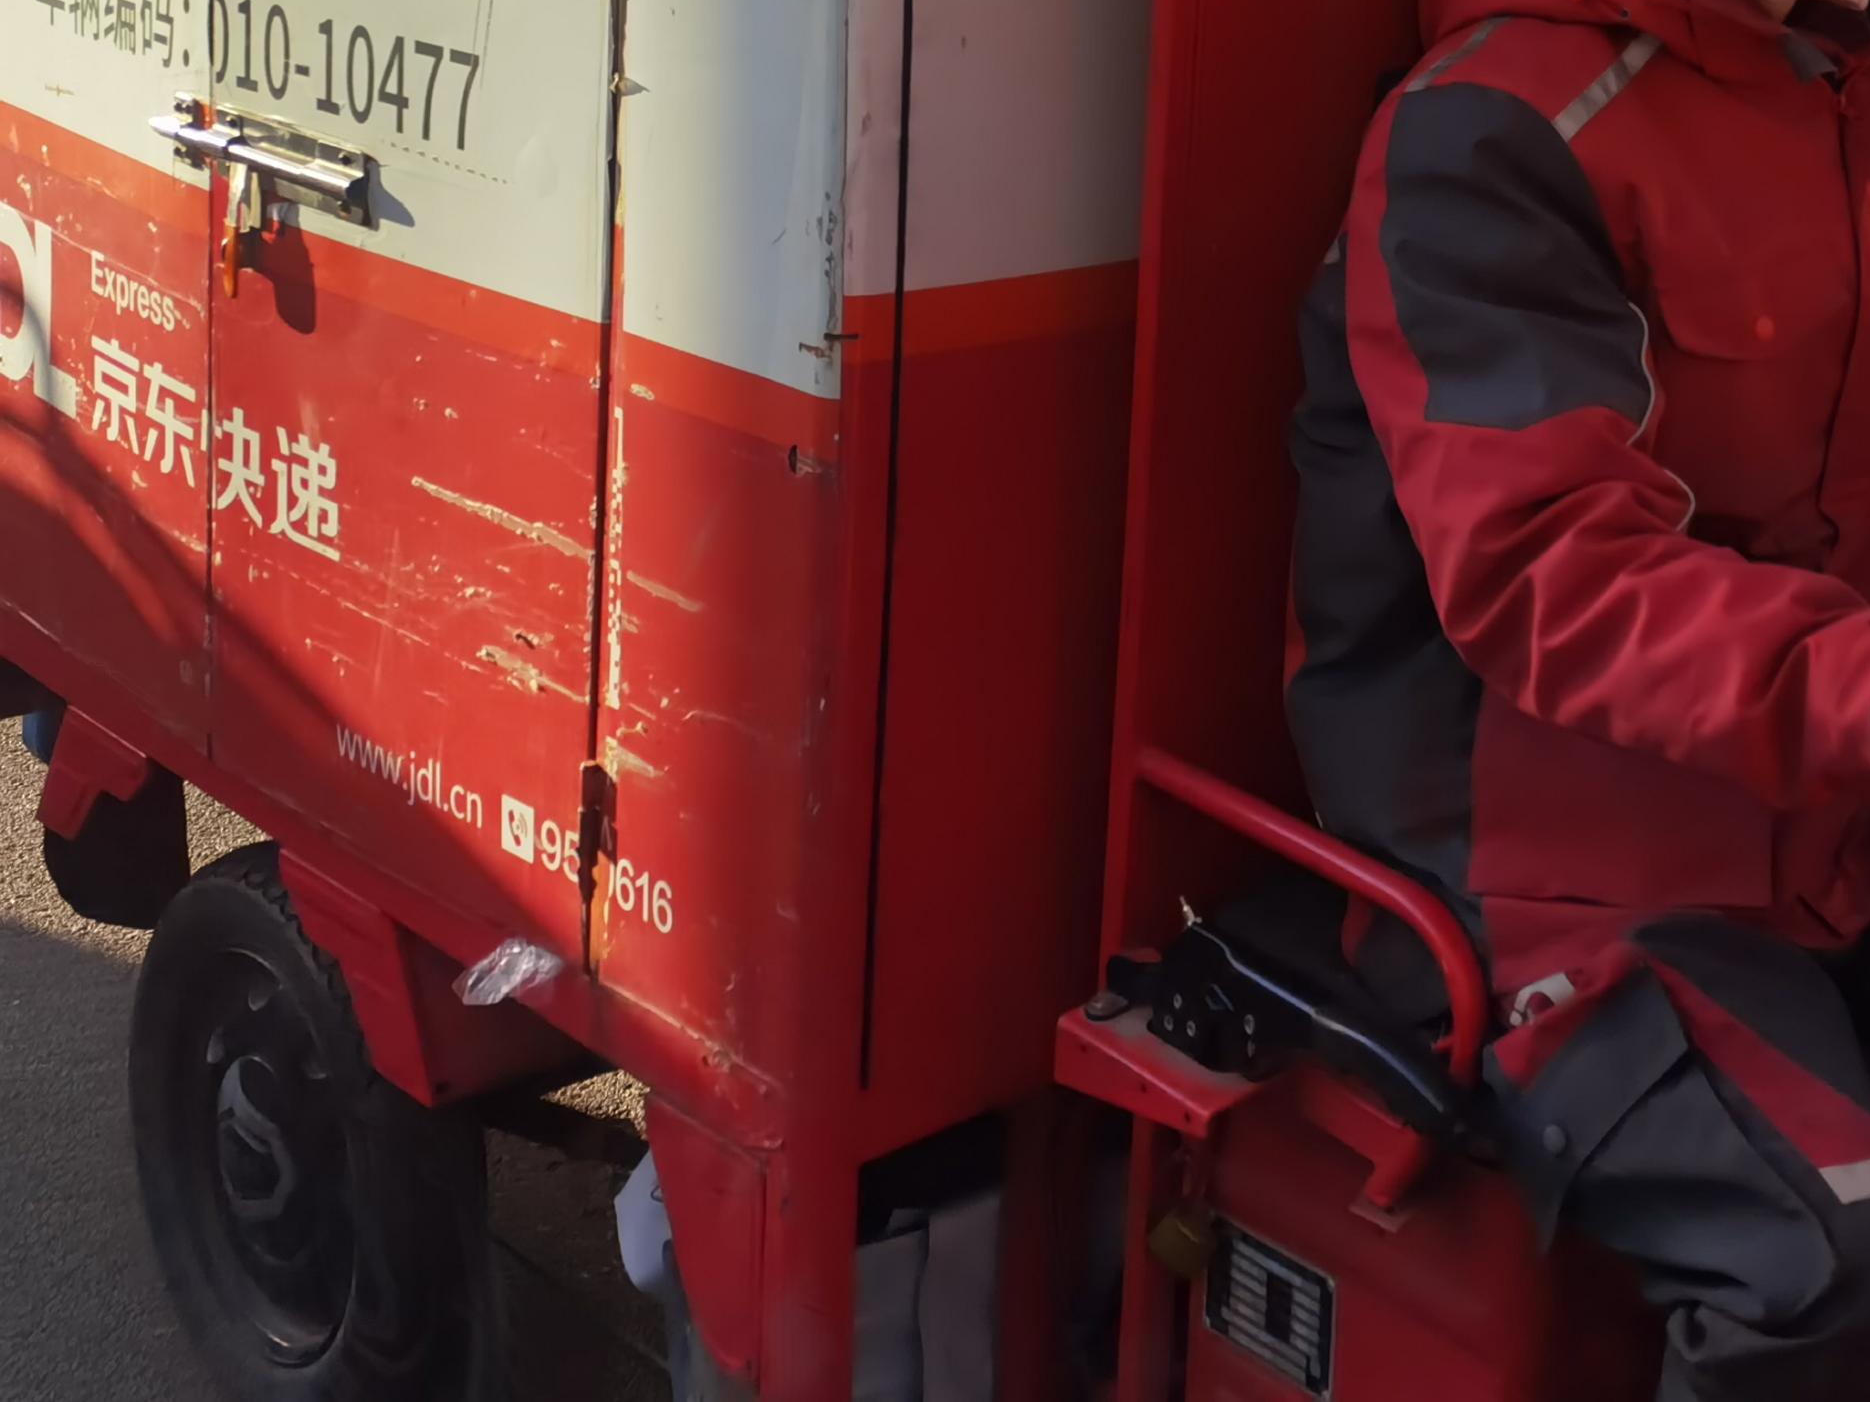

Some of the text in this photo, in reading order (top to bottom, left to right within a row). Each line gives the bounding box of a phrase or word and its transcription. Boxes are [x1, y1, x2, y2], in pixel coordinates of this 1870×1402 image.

[90, 250, 177, 333] Express
[90, 335, 341, 562] 京东快递
[336, 723, 674, 934] www.jdl.cn 95616
